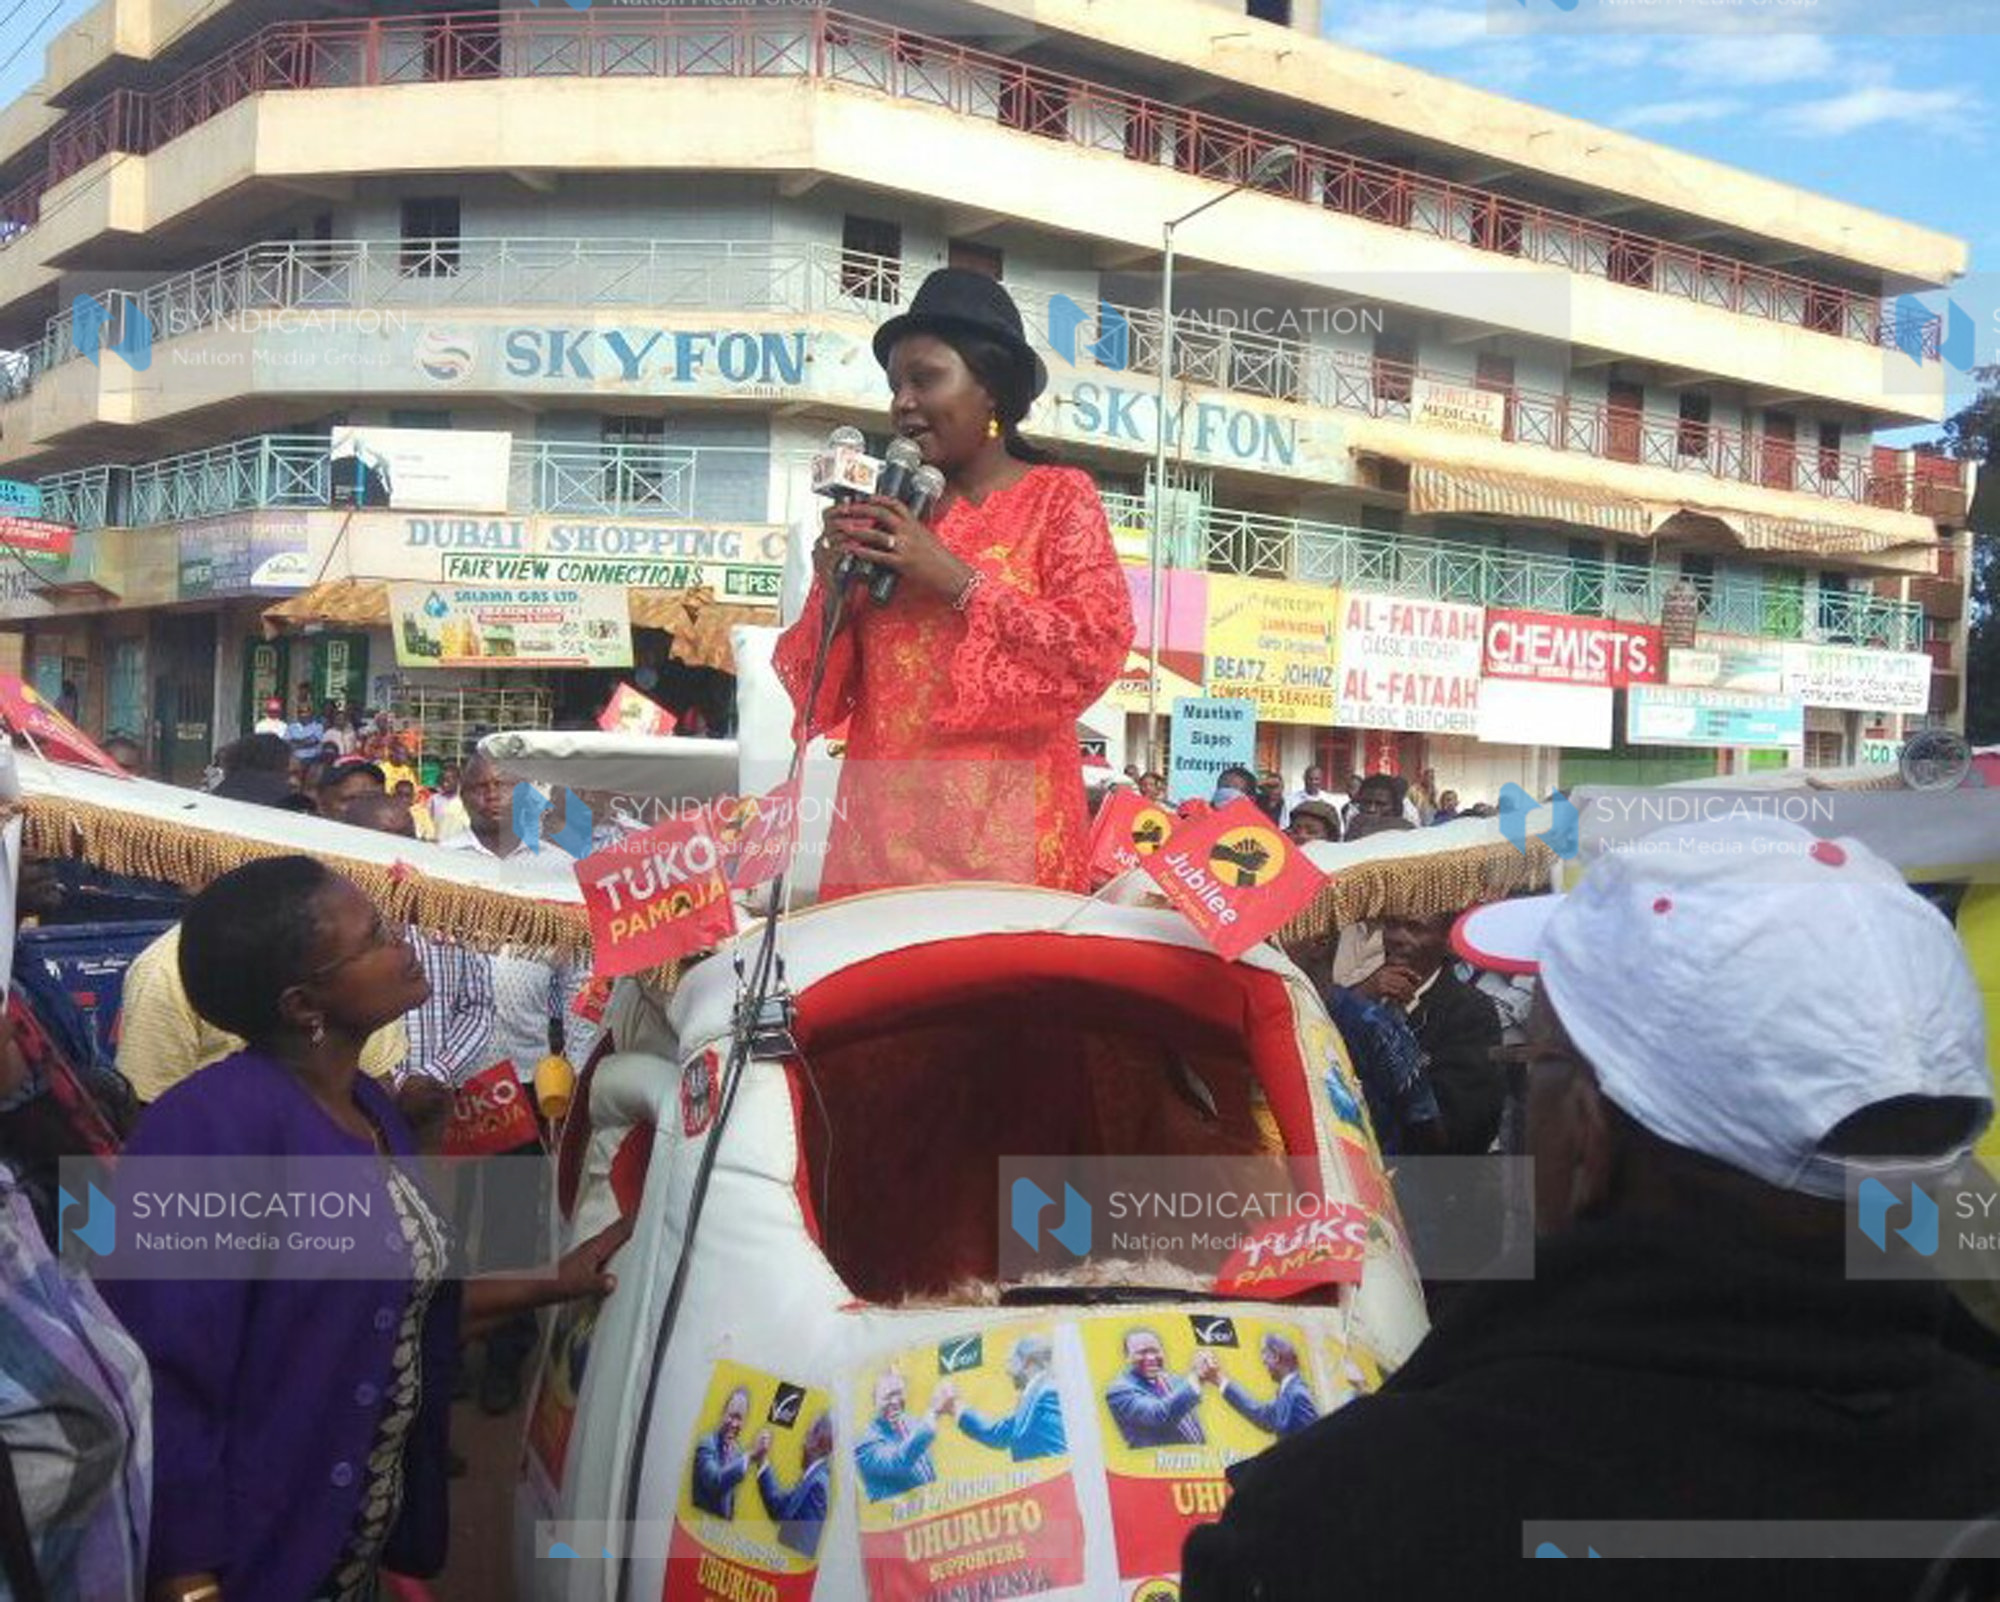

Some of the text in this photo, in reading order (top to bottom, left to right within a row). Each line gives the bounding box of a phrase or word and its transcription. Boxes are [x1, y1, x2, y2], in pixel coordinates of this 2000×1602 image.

[505, 329, 808, 385] SKYFON
[1071, 381, 1298, 466] SKYFON
[405, 518, 525, 549] DUBAI
[547, 524, 743, 559] SHOPPING
[448, 557, 704, 589] FAIRVIEW CONNECTIONS
[454, 589, 579, 603] SALAMA GAS LTD
[1487, 620, 1656, 674] CHEMISTS.
[1213, 656, 1334, 688] BEATZ JOHNZ
[1182, 704, 1244, 721] Mountain
[1278, 689, 1334, 709] SERVICES
[595, 834, 718, 912] TUKO
[1164, 851, 1239, 927] Jubilee
[608, 871, 726, 944] PAMOJA
[904, 1499, 1042, 1562] UHURUTO
[928, 1543, 1026, 1582] SUPPORTERS
